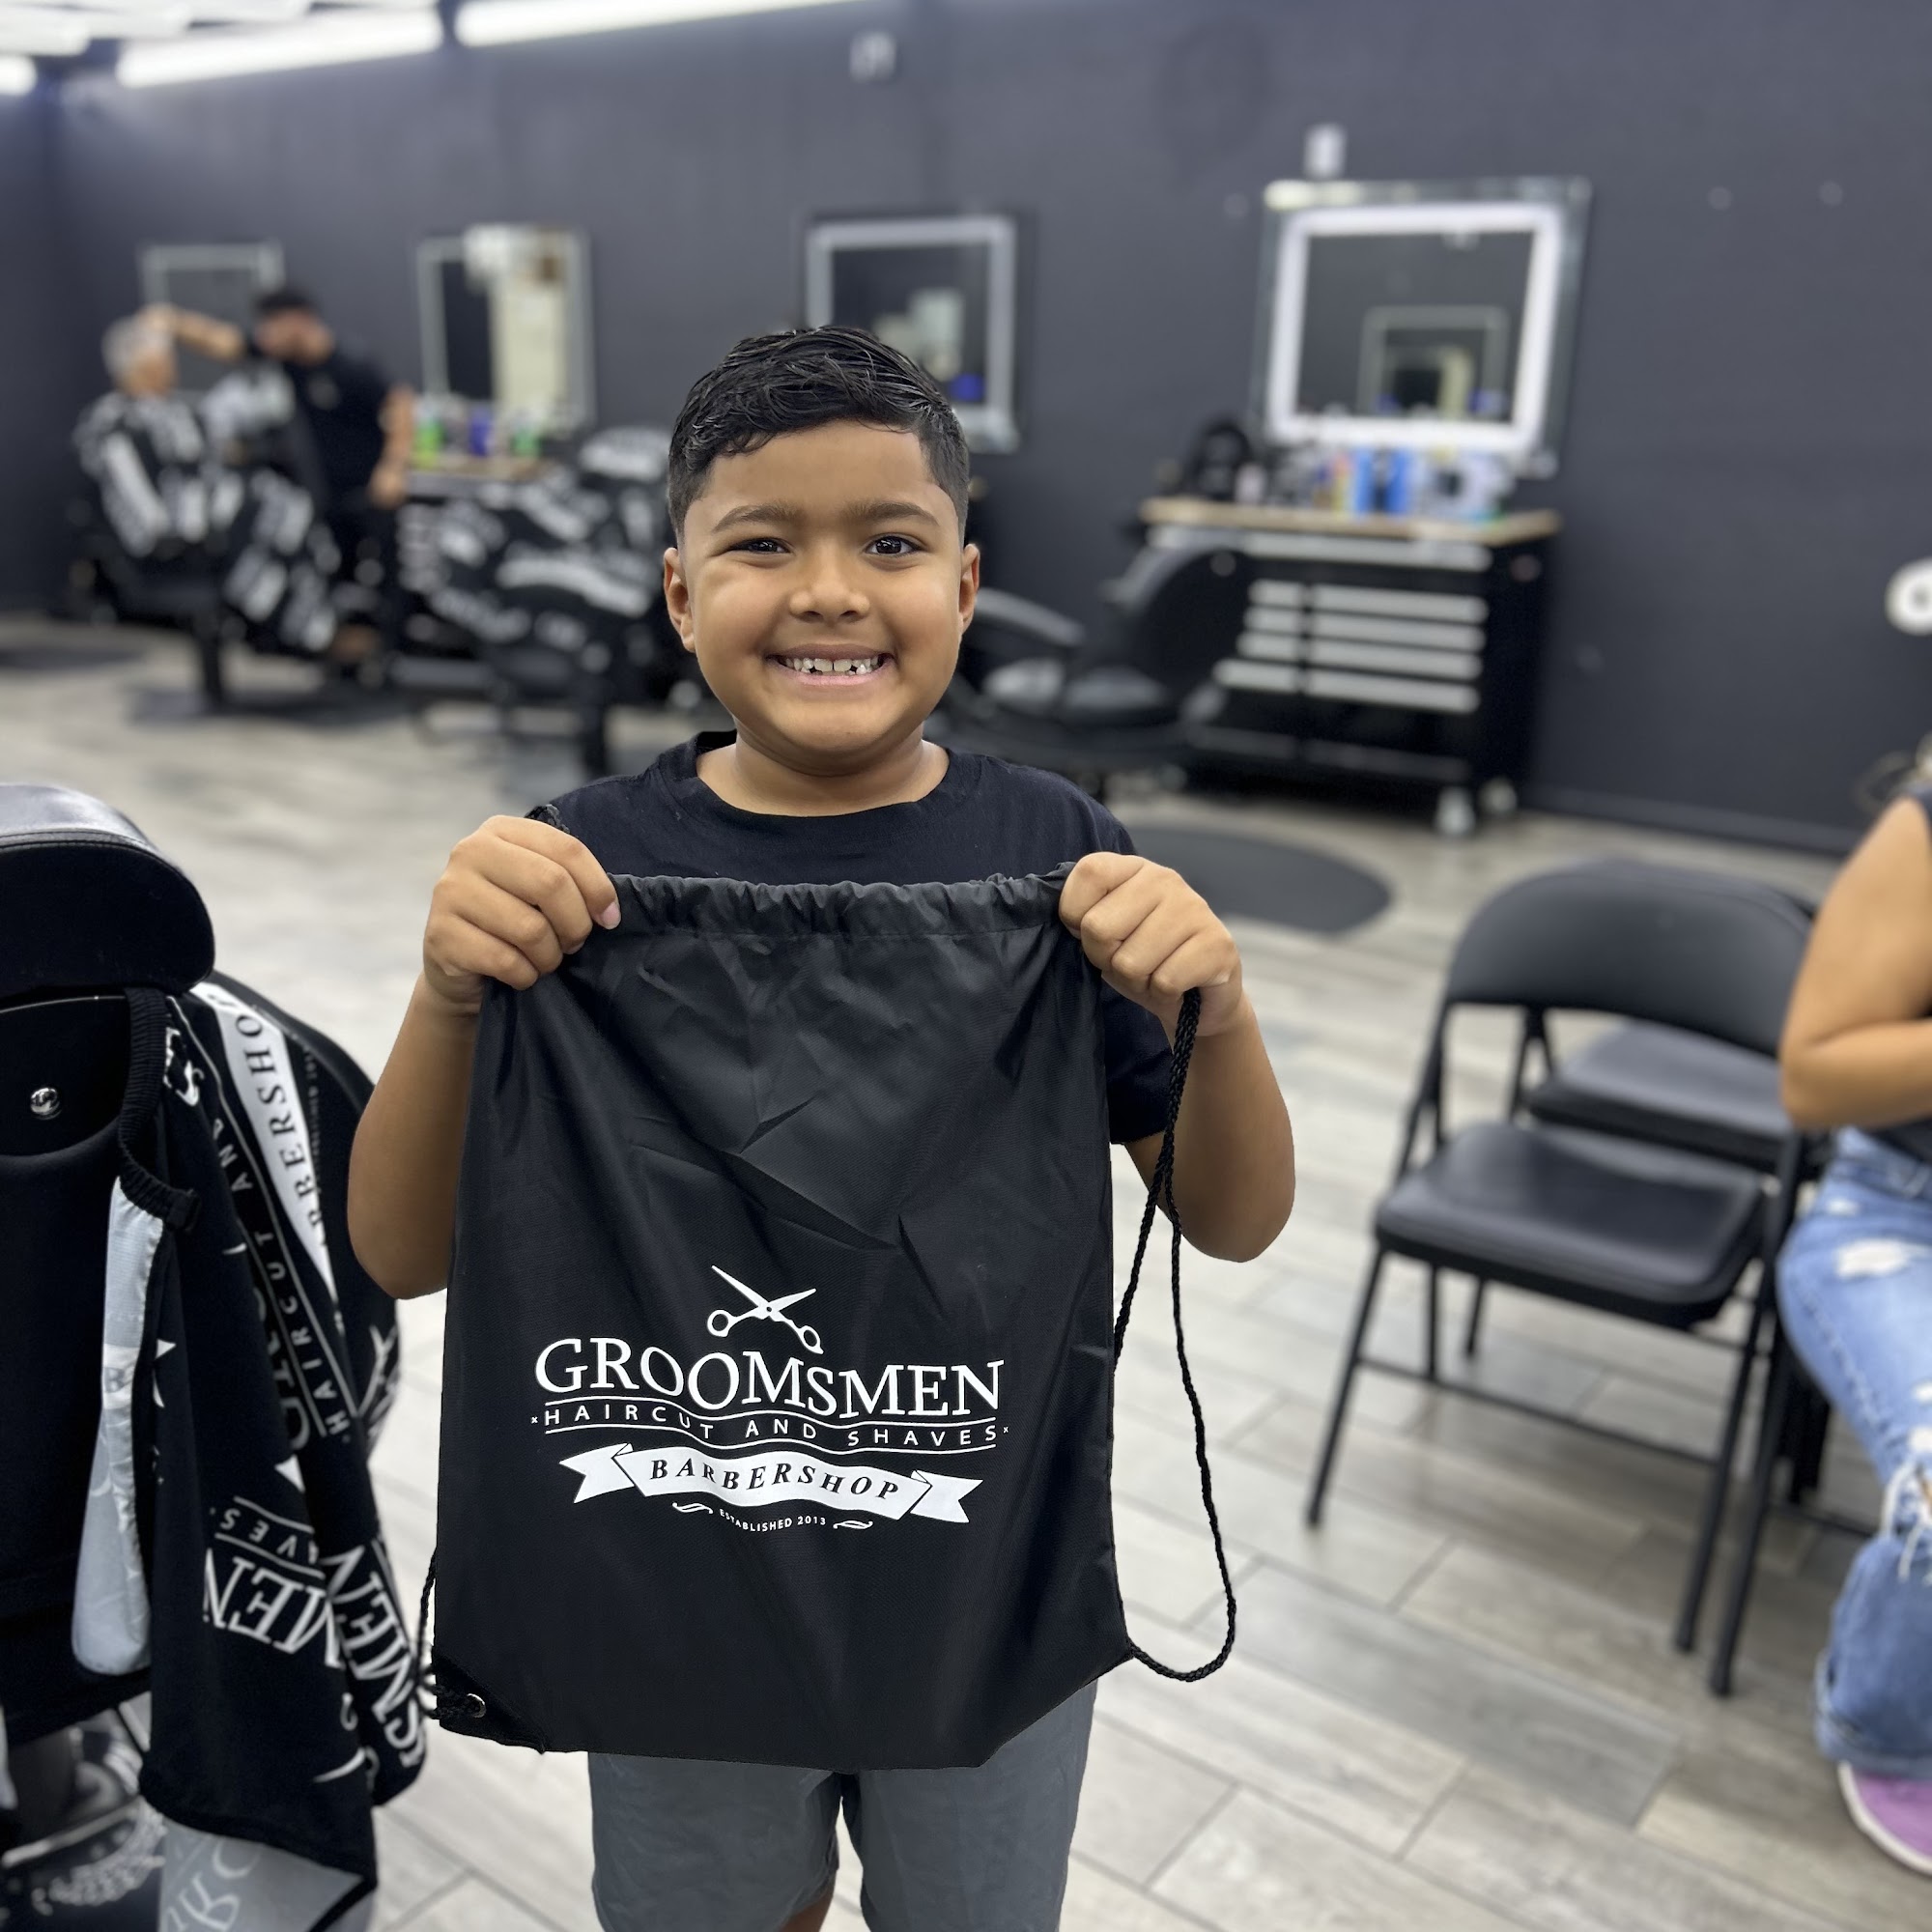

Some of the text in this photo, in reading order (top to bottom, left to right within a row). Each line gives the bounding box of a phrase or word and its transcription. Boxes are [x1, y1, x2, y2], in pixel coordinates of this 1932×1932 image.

[254, 1230, 351, 1435] HAIRCUT
[534, 1337, 1005, 1419] GROOMSMEN
[544, 1404, 997, 1447] HAIRCUT AND SHAVES
[649, 1458, 899, 1500] BARBERSHOP
[719, 1508, 827, 1532] ESTABLISHED 2013
